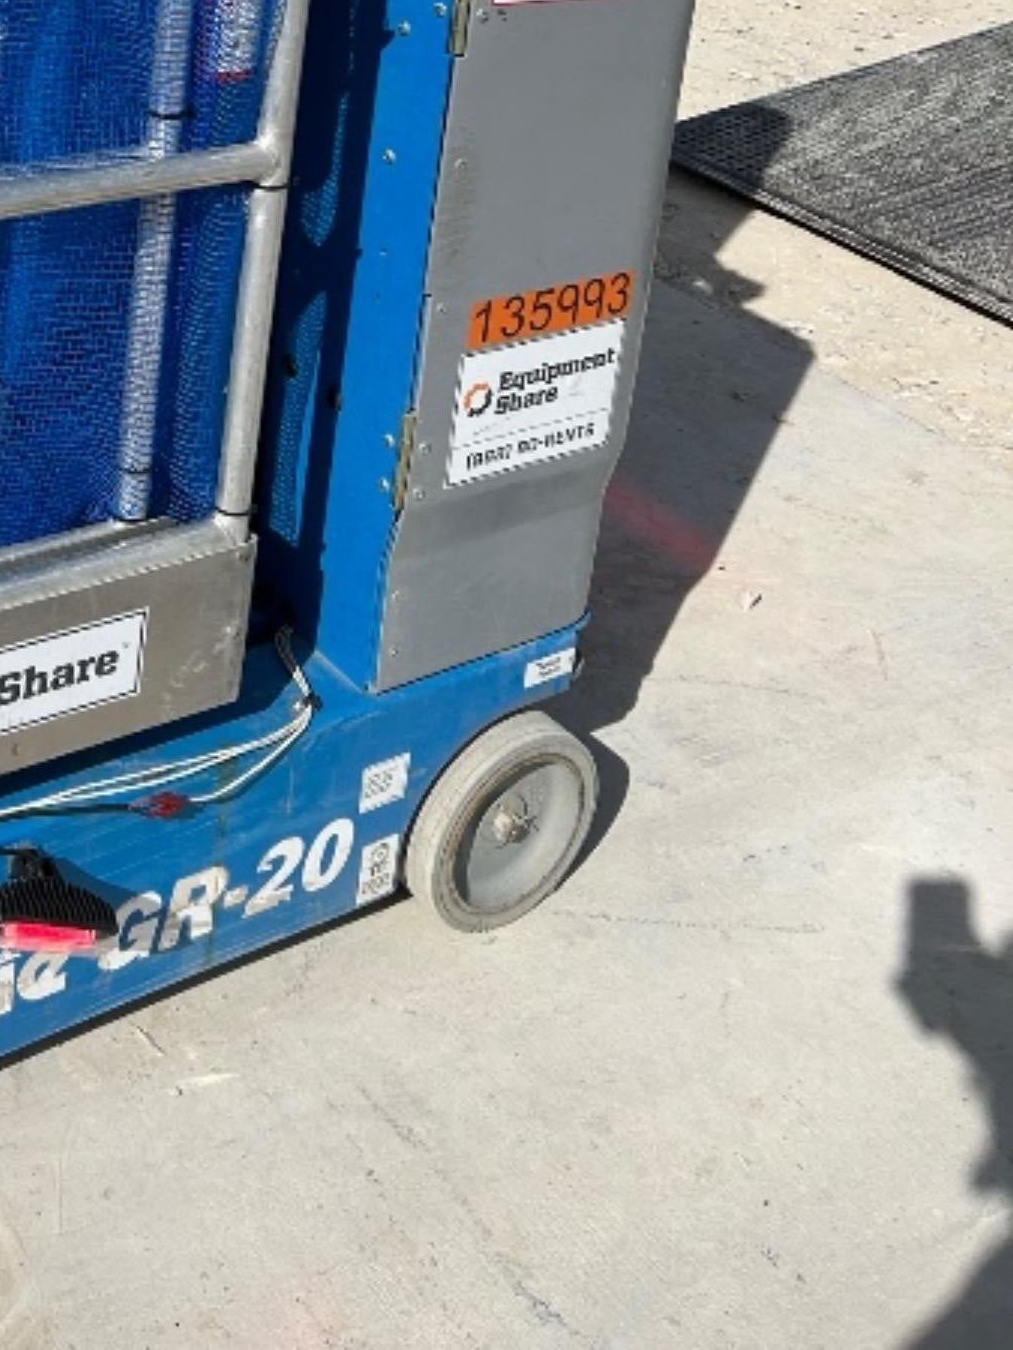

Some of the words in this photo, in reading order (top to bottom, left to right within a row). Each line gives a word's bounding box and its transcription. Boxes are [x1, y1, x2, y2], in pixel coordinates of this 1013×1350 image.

[474, 271, 631, 343] 135993
[498, 347, 616, 391] Equipment
[493, 386, 559, 415] Share
[98, 817, 355, 971] GR-20
